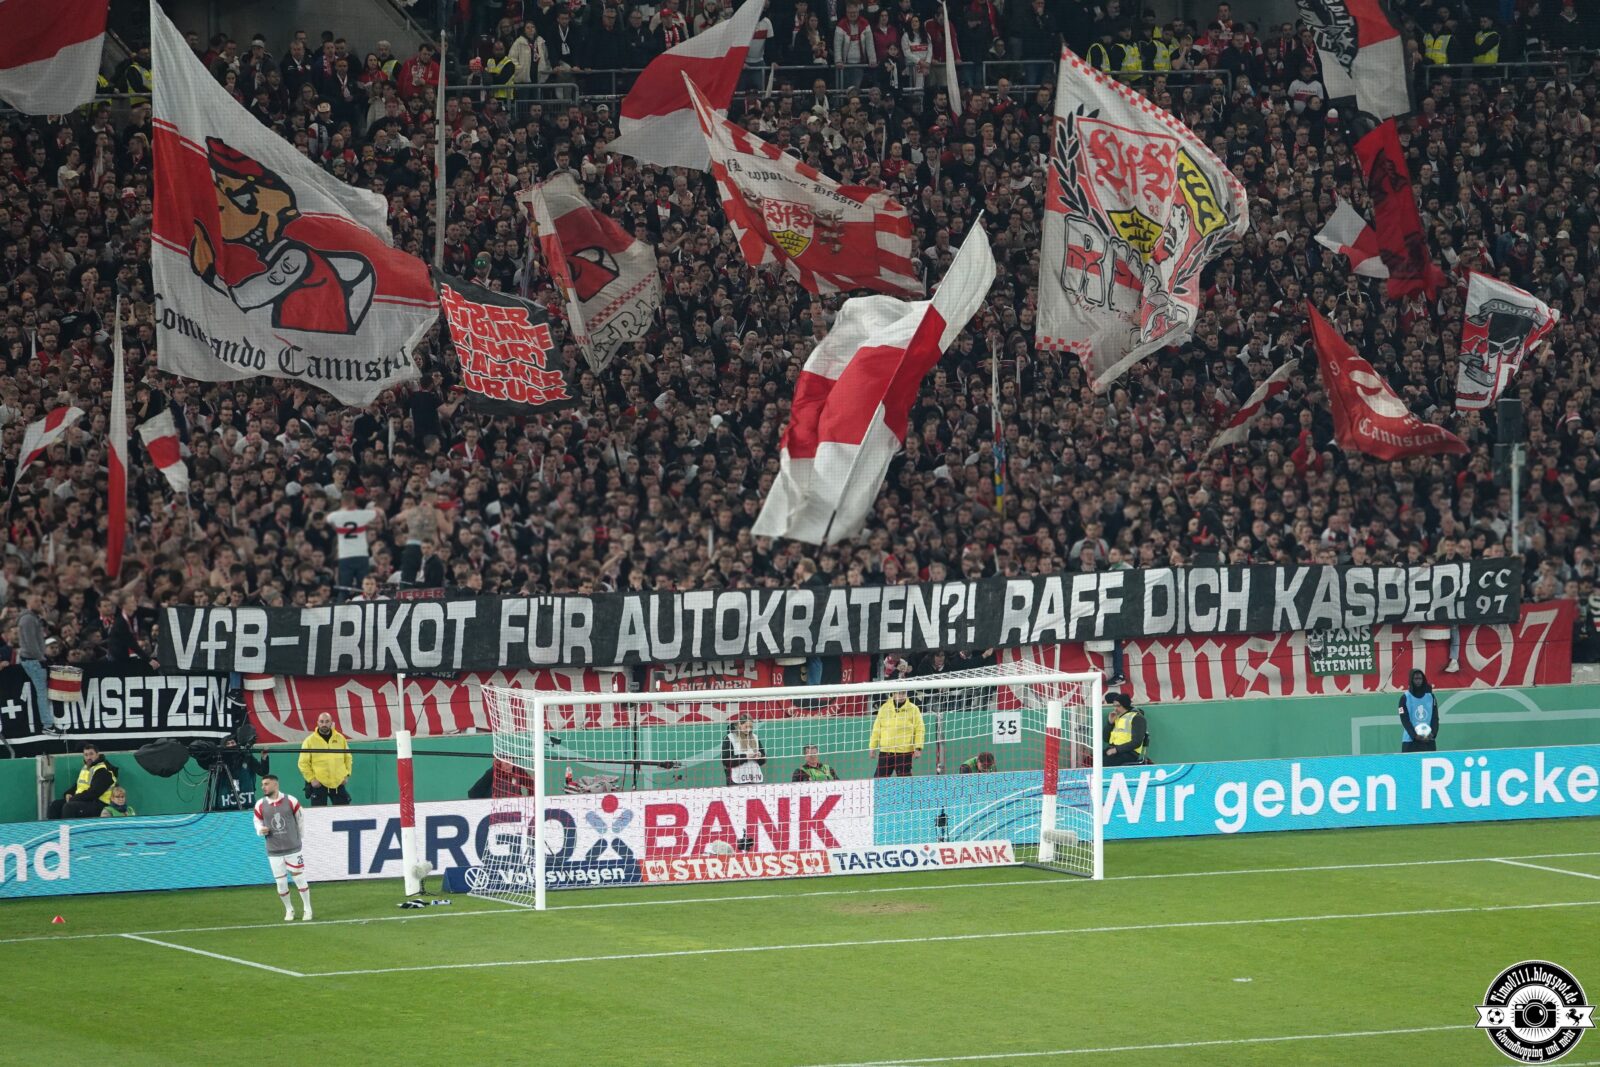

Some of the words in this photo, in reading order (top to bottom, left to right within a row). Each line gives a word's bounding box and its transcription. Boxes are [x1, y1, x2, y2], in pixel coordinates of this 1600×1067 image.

[448, 321, 547, 369] KEHRT
[343, 521, 358, 539] 2
[1478, 568, 1512, 589] CC
[1475, 594, 1509, 615] 97
[167, 600, 477, 675] VfB-TRIKOT
[498, 596, 593, 666] FÜR
[614, 582, 977, 663] AUTOKRATEN?!
[999, 571, 1124, 645] RAFF
[1143, 567, 1250, 635] DICH
[1273, 562, 1471, 632] KASPER!
[1326, 626, 1371, 643] FANS
[1326, 643, 1371, 658] POUR
[1465, 608, 1559, 688] 97
[772, 672, 783, 686] 19
[842, 669, 853, 682] 97
[996, 719, 1018, 735] 35
[221, 791, 255, 807] HOST
[1089, 768, 1195, 825] Wir
[1214, 763, 1397, 834] geben
[1421, 751, 1599, 809] Rücke
[671, 853, 800, 881] STRAUSS
